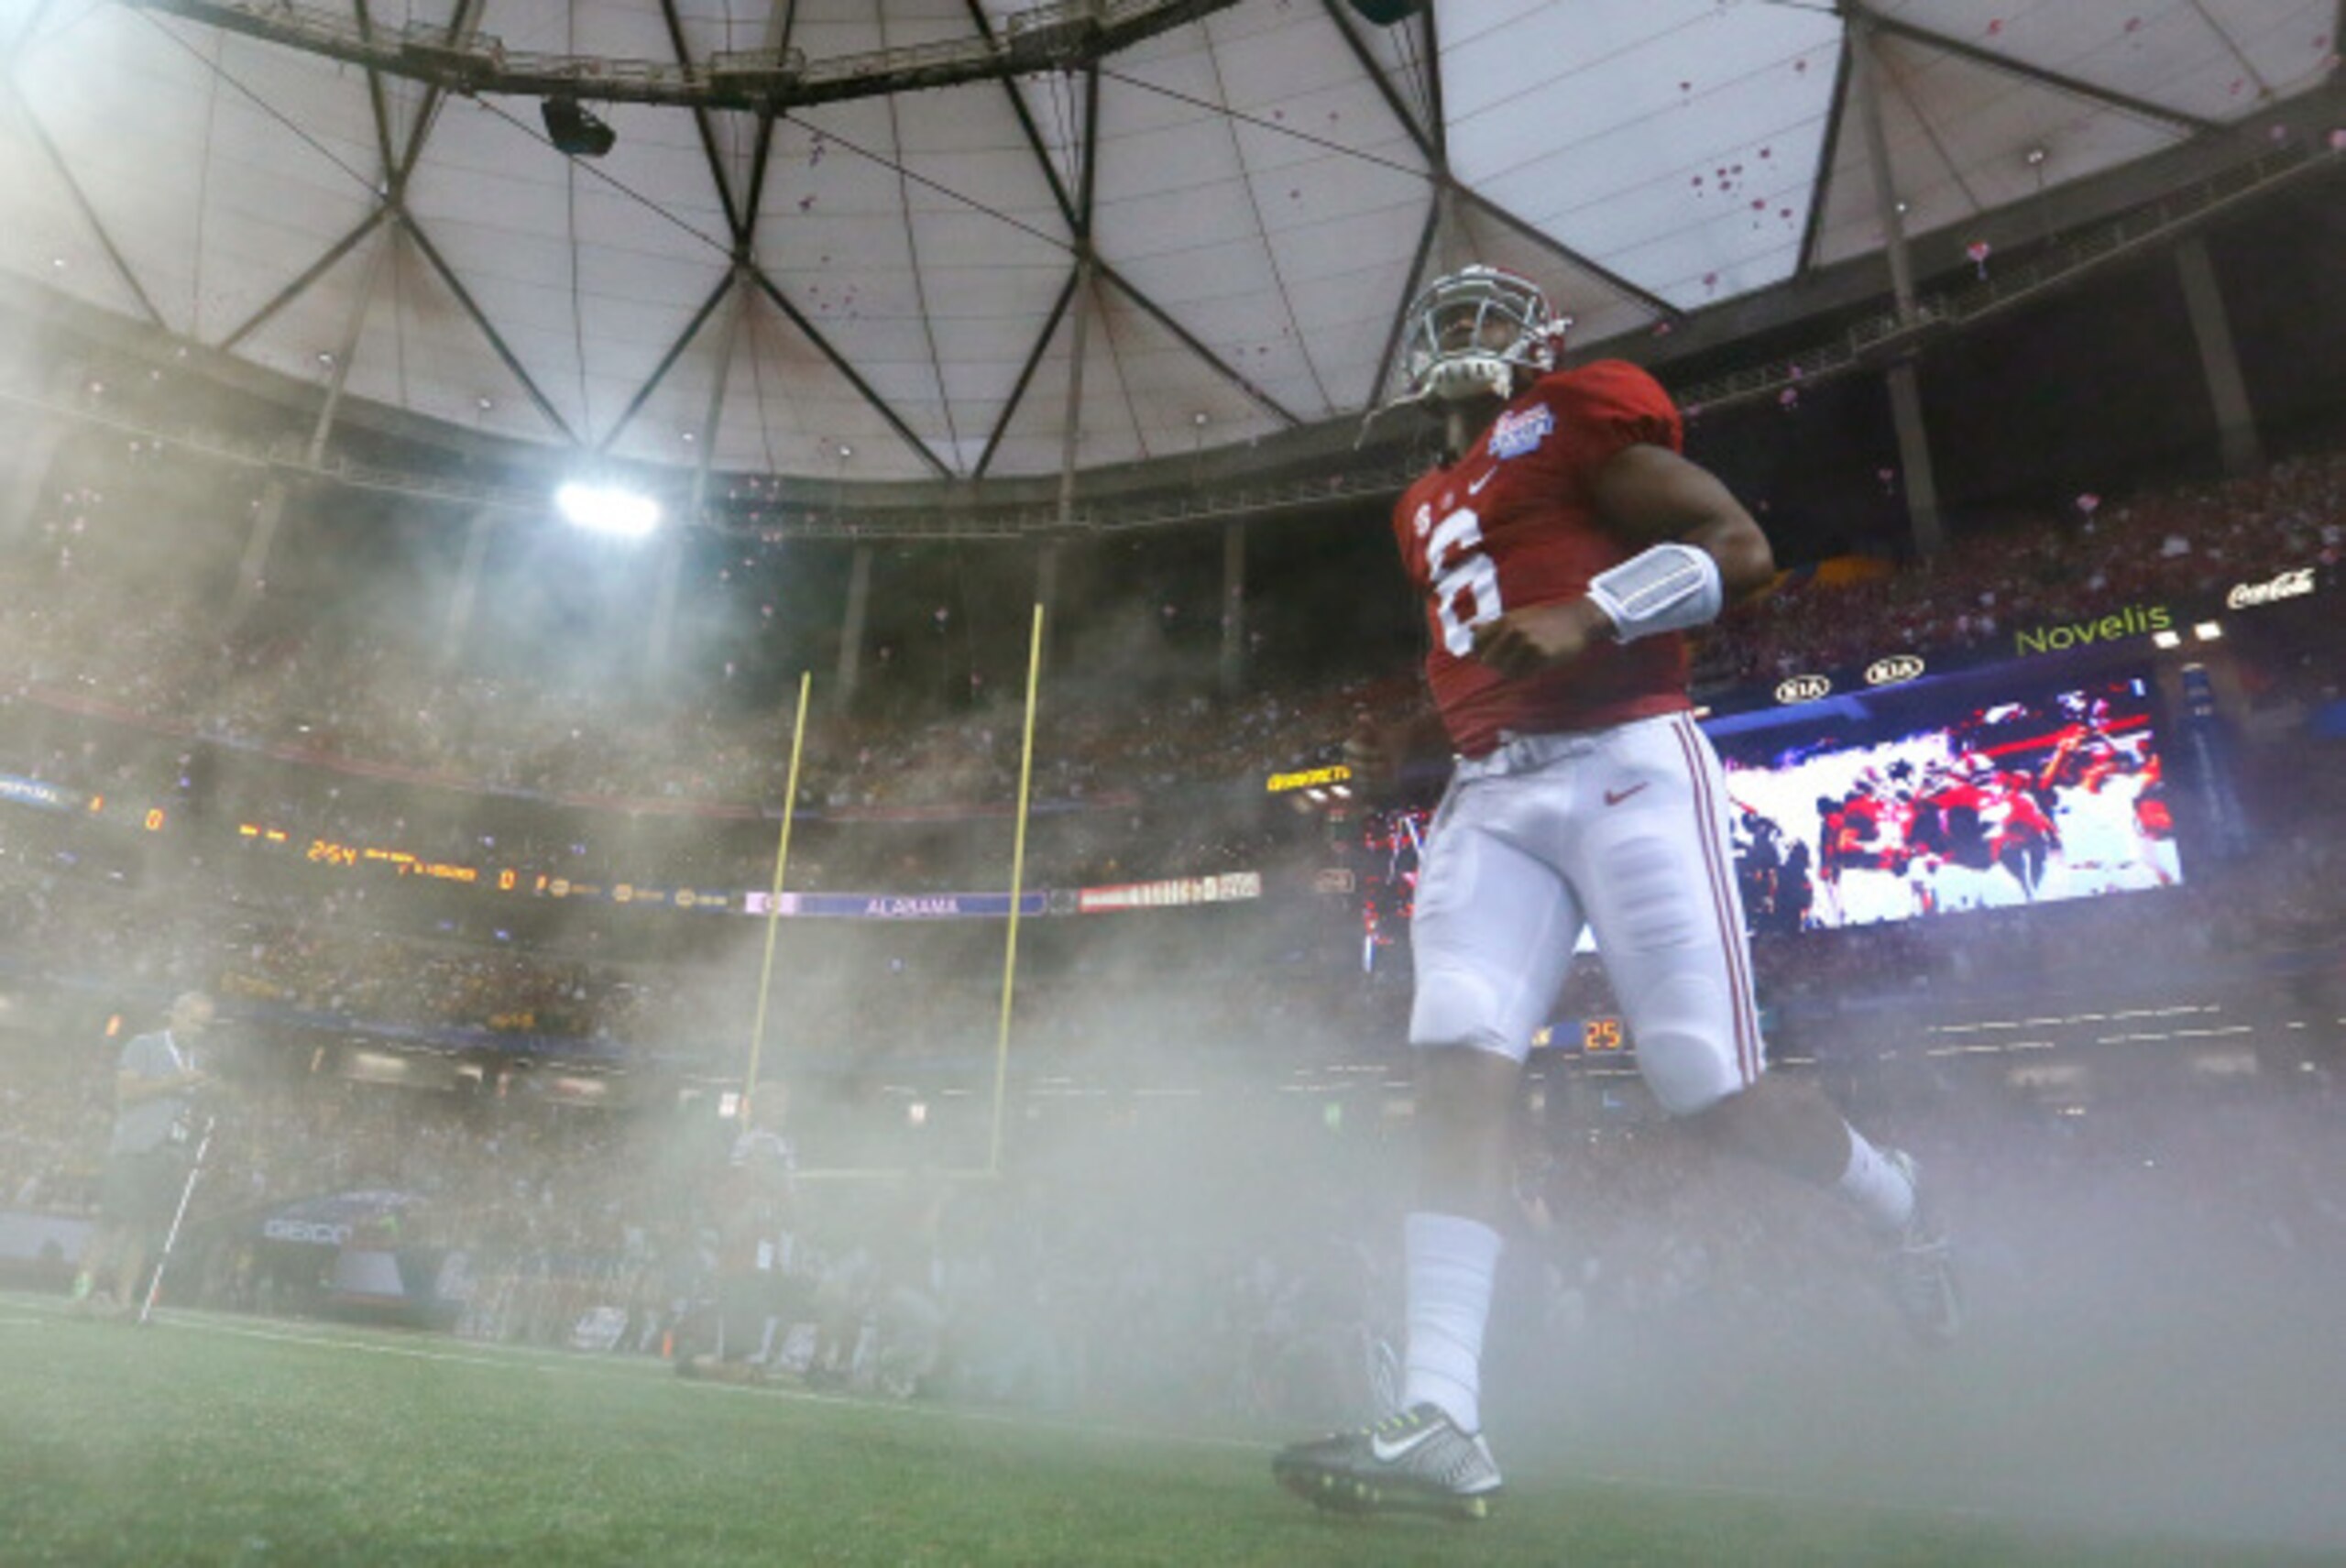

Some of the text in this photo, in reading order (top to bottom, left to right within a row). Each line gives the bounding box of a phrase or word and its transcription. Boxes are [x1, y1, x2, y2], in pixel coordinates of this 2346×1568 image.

[1426, 507, 1503, 658] 6
[2016, 605, 2172, 656] Novelis
[1868, 657, 1922, 684] KIA
[1778, 676, 1828, 703] KIA
[865, 897, 960, 917] ALABAMA
[1584, 1021, 1621, 1049] 25
